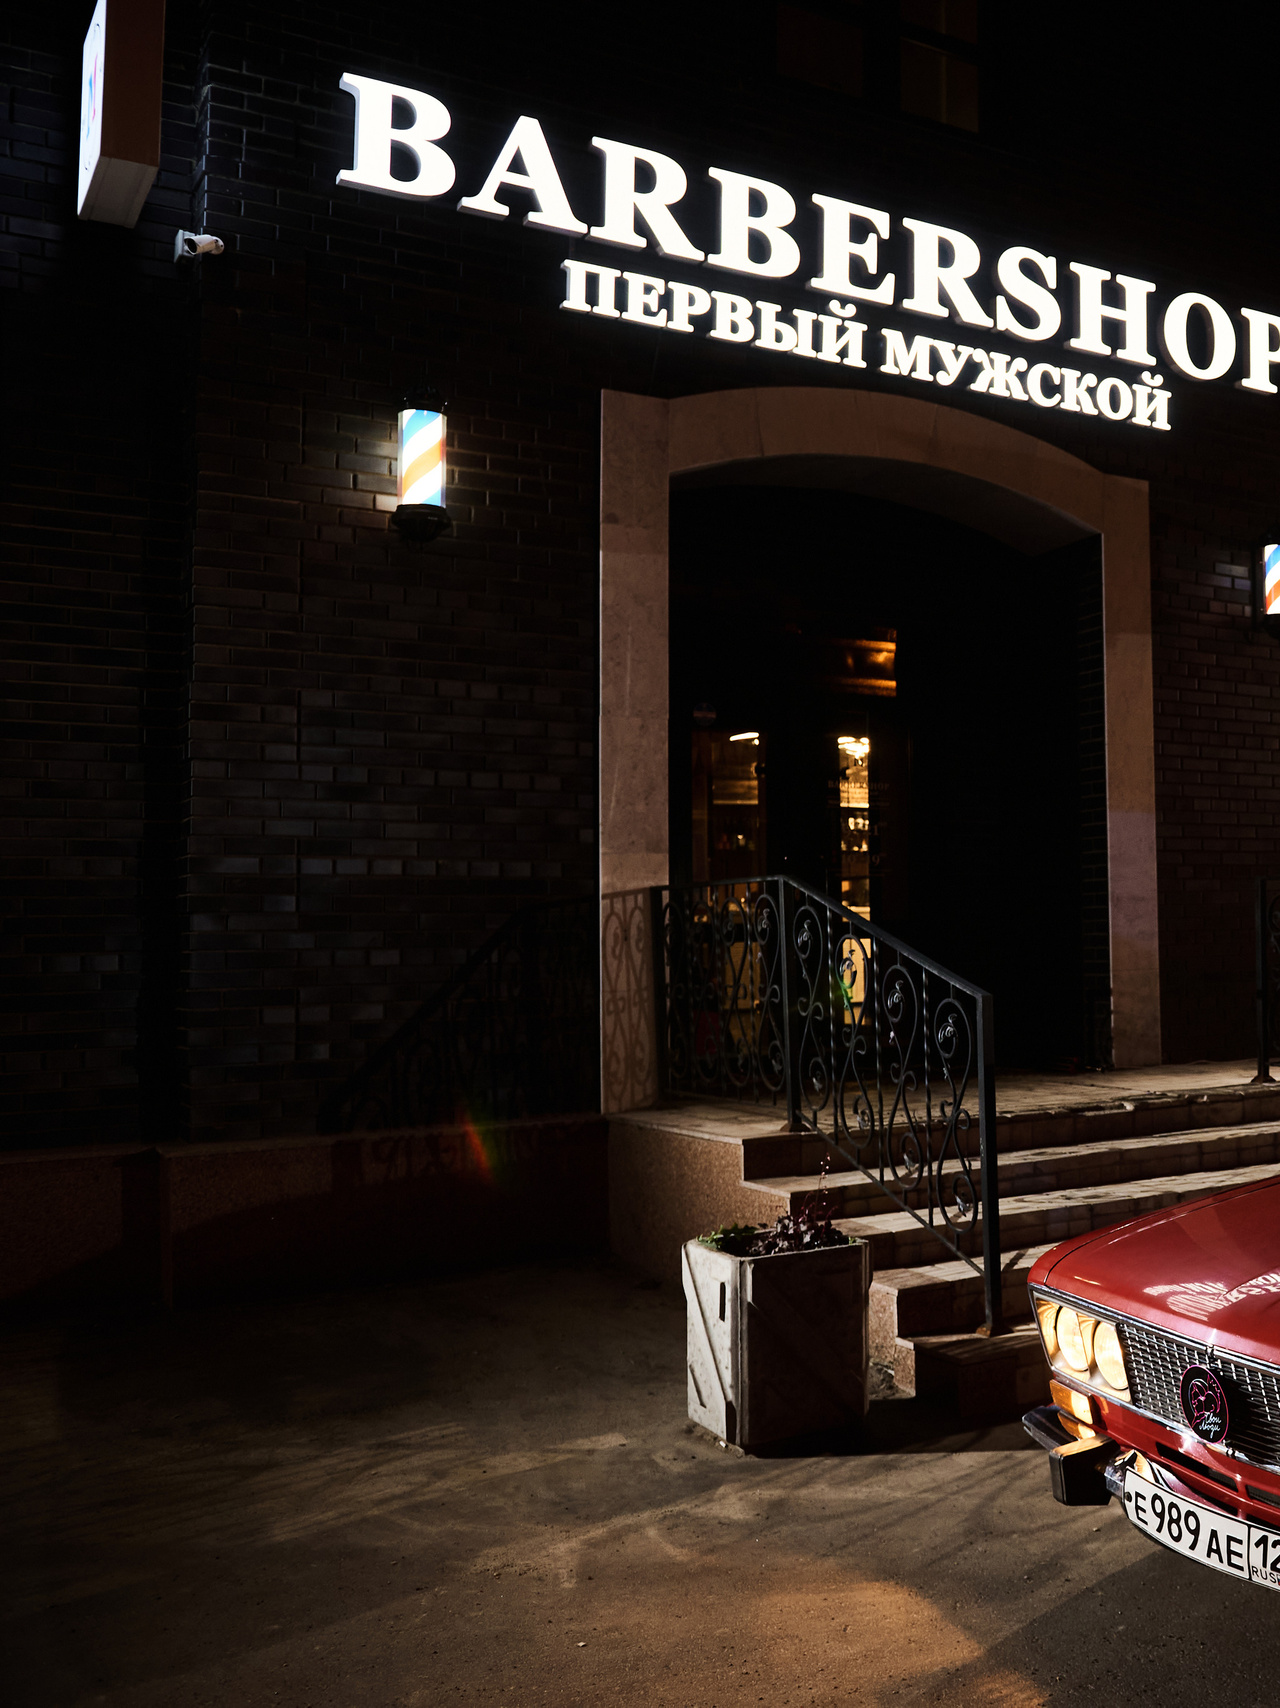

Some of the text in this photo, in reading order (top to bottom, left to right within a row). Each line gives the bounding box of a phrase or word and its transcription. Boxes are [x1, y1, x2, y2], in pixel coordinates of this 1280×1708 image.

[560, 258, 1172, 431] ПЕРВЫЙ МУЖСКОЙ
[1251, 1566, 1277, 1584] RUS
